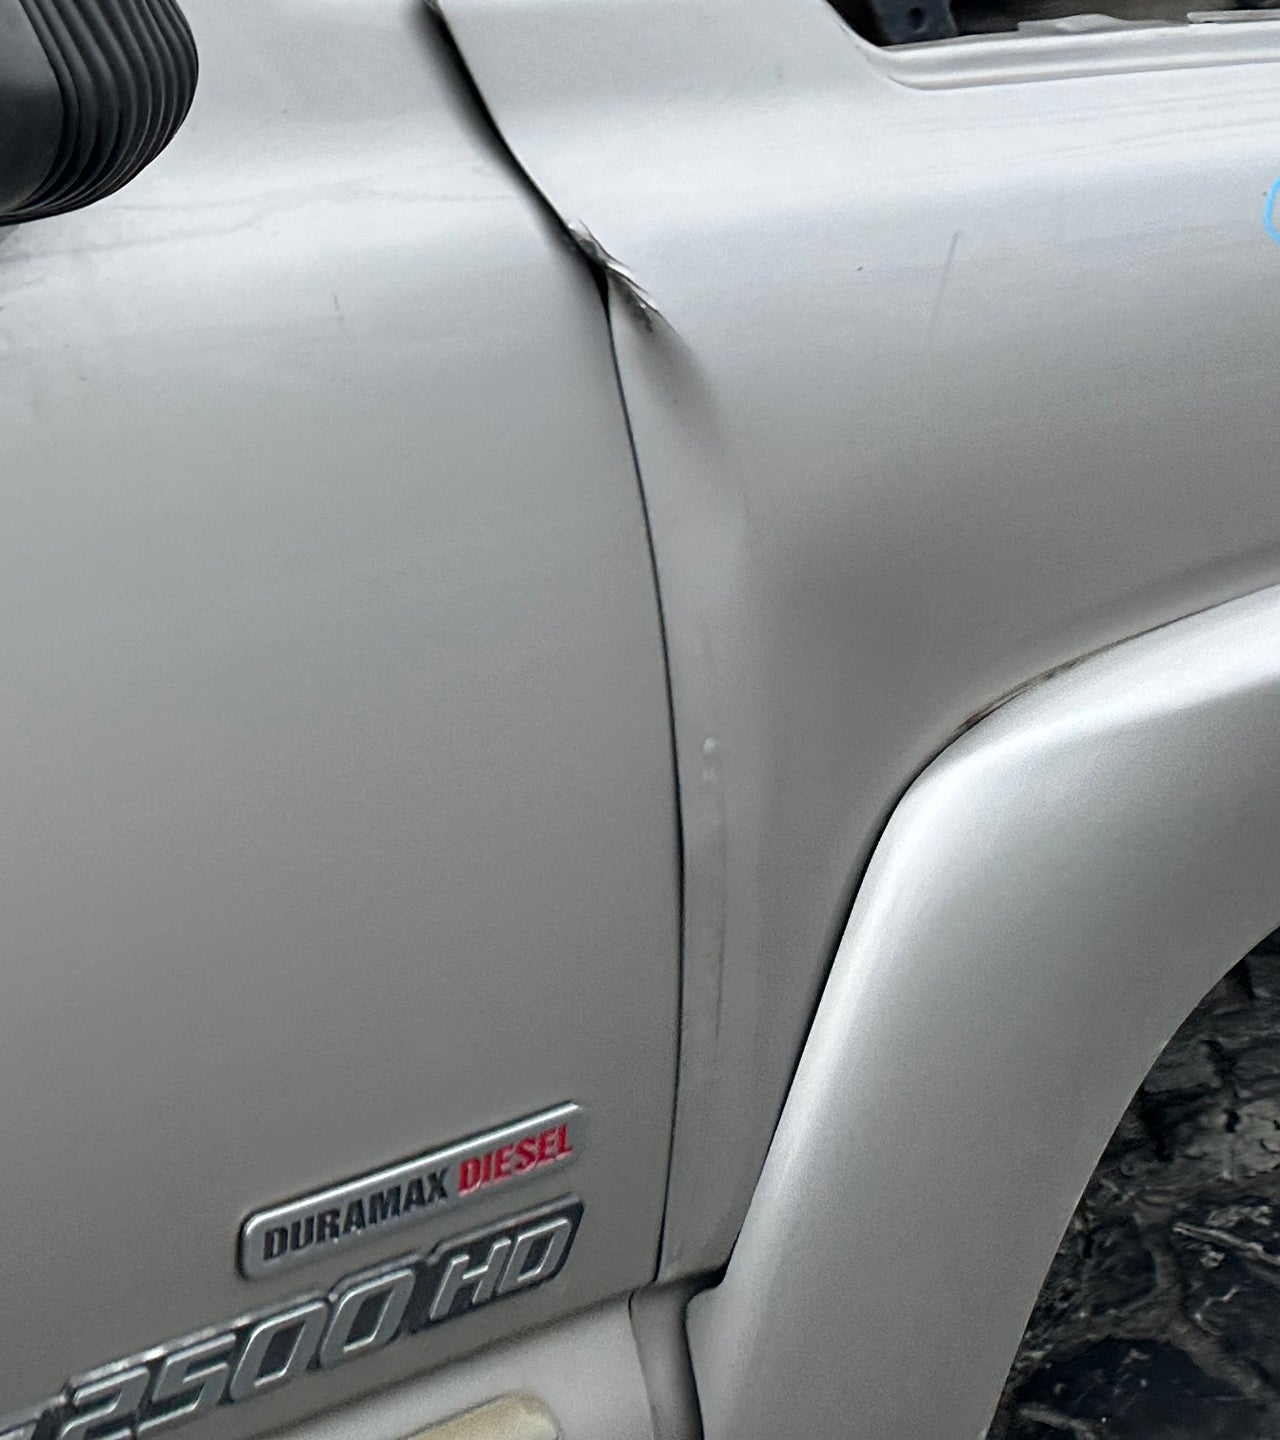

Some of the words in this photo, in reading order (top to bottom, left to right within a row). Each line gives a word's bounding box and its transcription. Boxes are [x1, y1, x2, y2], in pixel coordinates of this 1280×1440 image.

[263, 1167, 450, 1261] DURAMAX
[458, 1123, 575, 1196] DIESEL
[54, 1266, 416, 1440] 2500
[429, 1217, 573, 1322] HD
